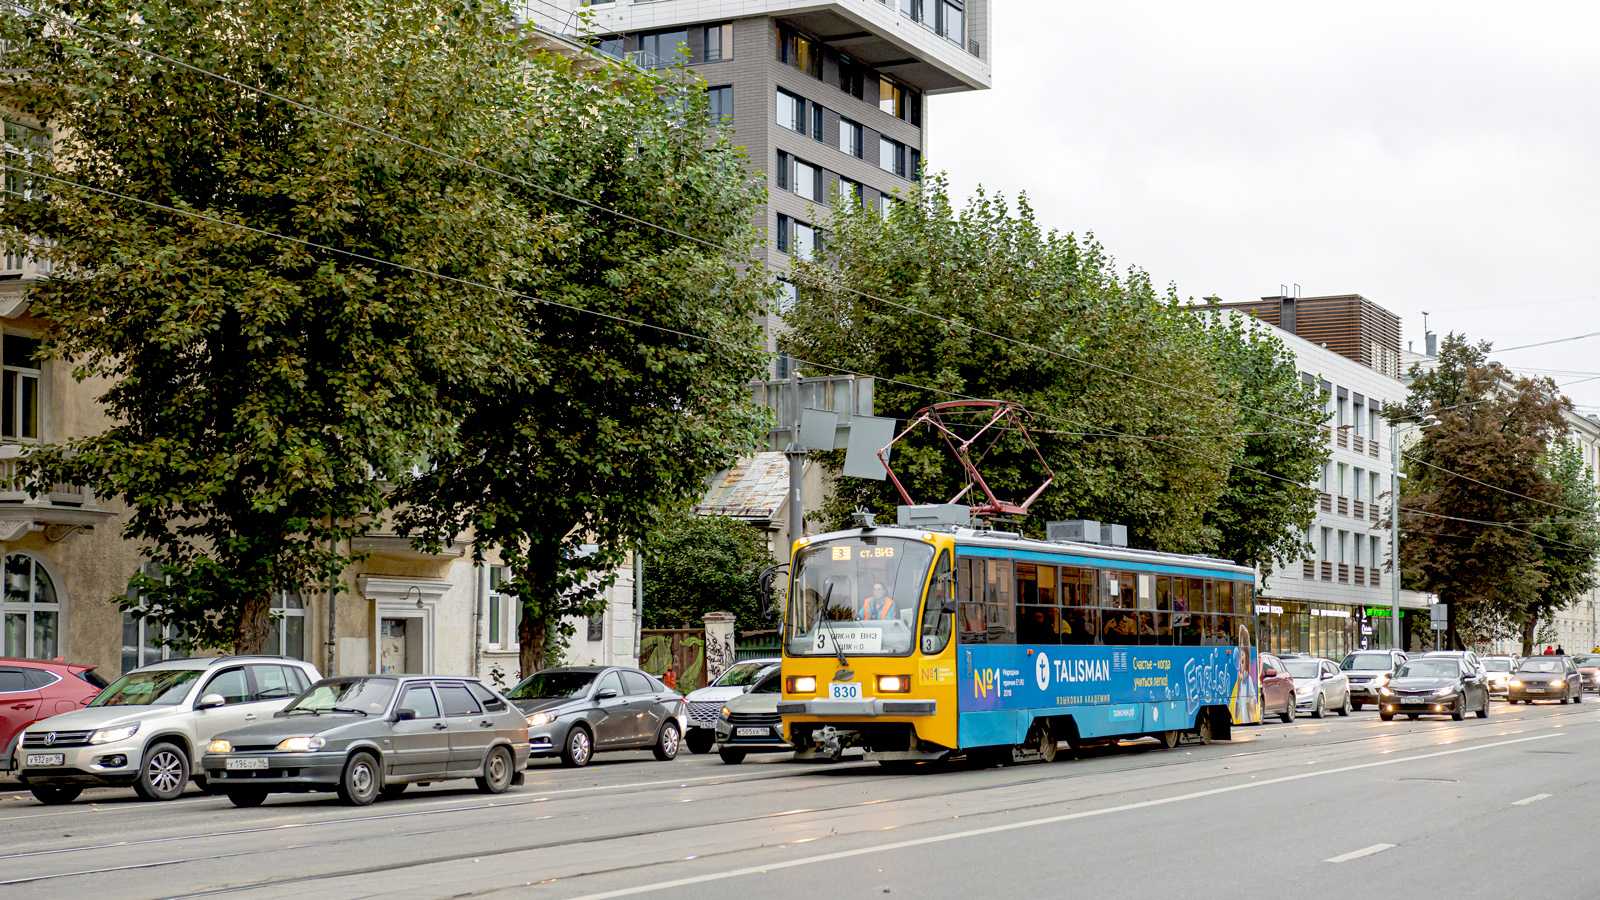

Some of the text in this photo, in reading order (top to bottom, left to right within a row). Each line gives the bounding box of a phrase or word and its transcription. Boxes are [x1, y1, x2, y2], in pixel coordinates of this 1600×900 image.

[838, 548, 844, 558] 3
[874, 547, 894, 558] ВИЗ
[817, 634, 826, 649] 3
[926, 639, 932, 651] 3
[1133, 657, 1152, 670] Счастье
[1157, 660, 1171, 671] когда
[1054, 660, 1110, 682] TALISMAN
[1134, 674, 1168, 691] учиться легко!
[1184, 653, 1231, 716] English
[834, 686, 856, 698] 830
[1084, 694, 1110, 704] АКАДЕМИЯ
